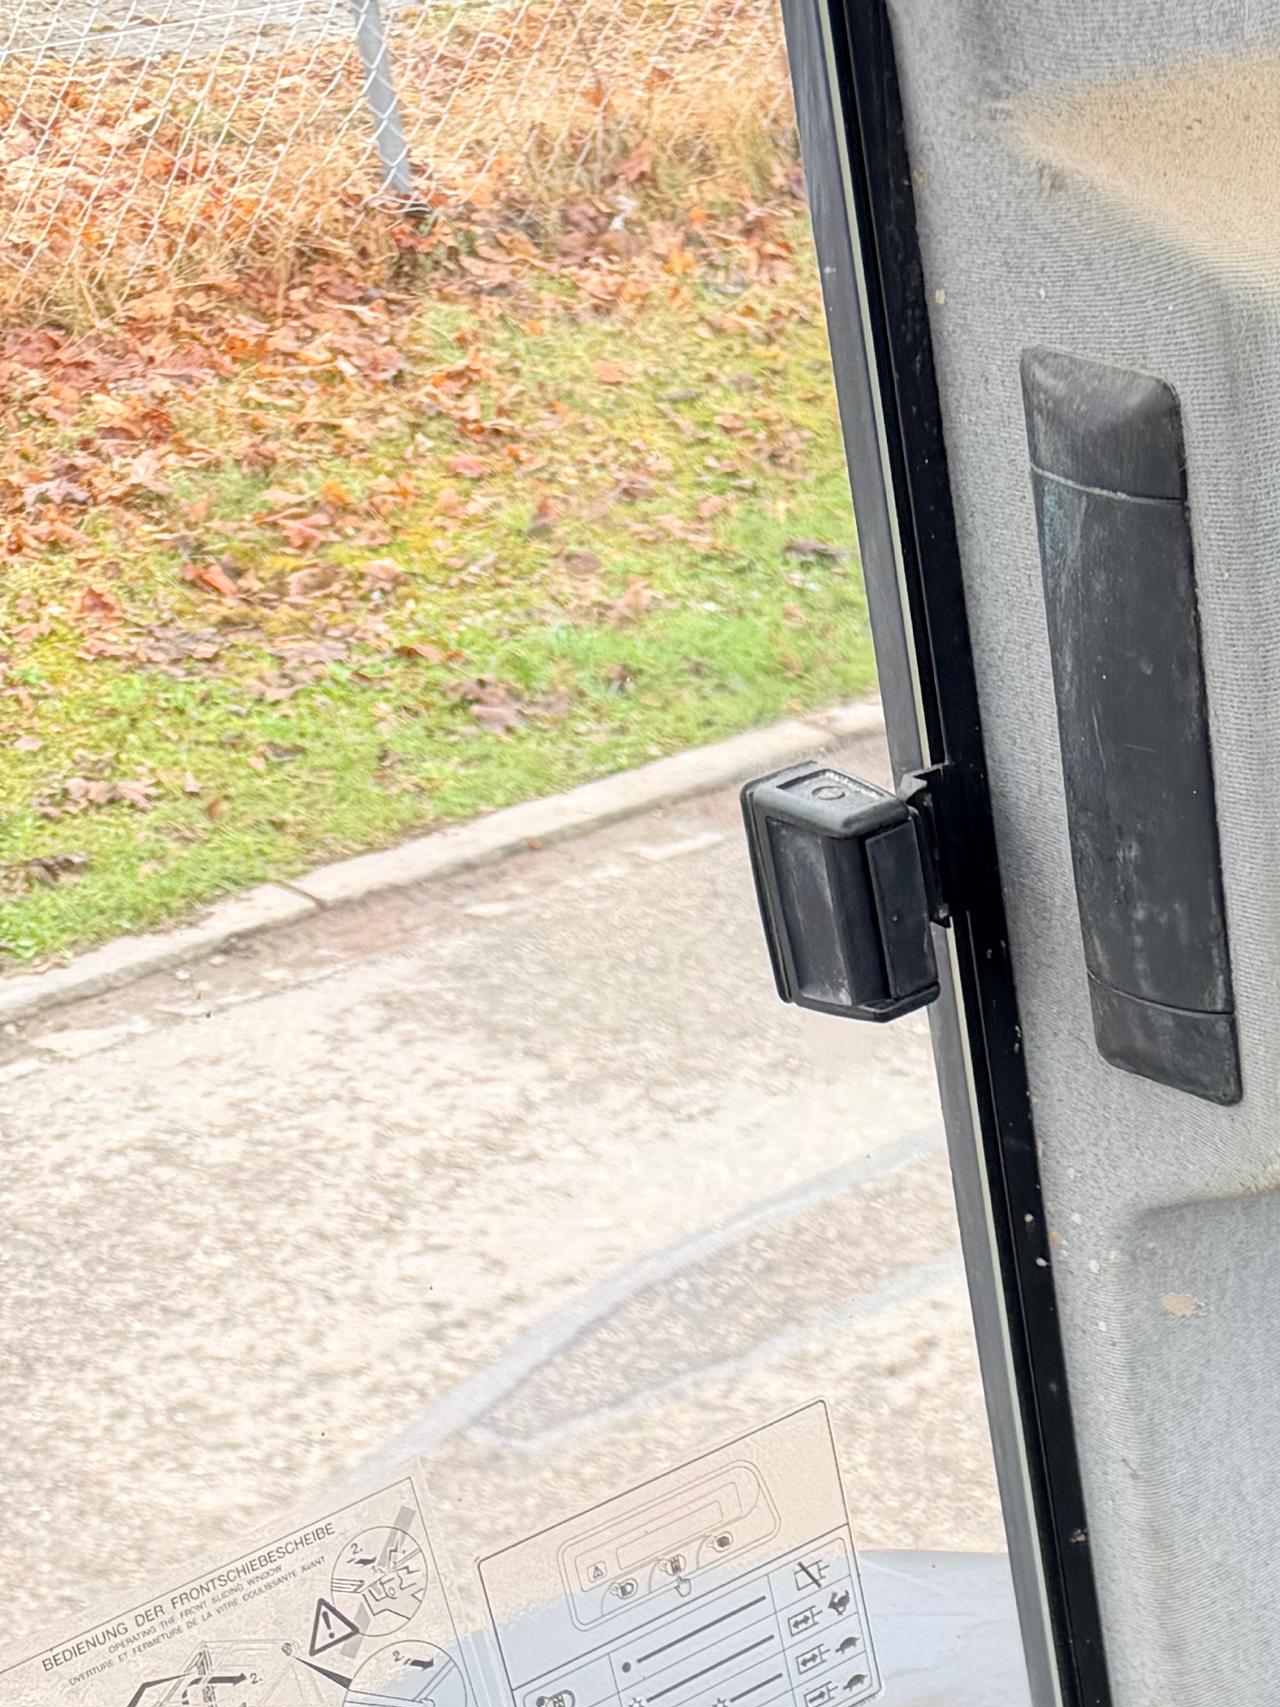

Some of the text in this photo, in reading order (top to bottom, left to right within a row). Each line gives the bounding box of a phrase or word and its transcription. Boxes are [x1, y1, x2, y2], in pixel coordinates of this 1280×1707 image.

[42, 1523, 335, 1671] BEDIENUNG DER FRONTSCHIEBESCHEIBE
[108, 1625, 156, 1654] OPERATING
[180, 1603, 208, 1618] FRONT
[247, 1564, 283, 1586] WINDOW
